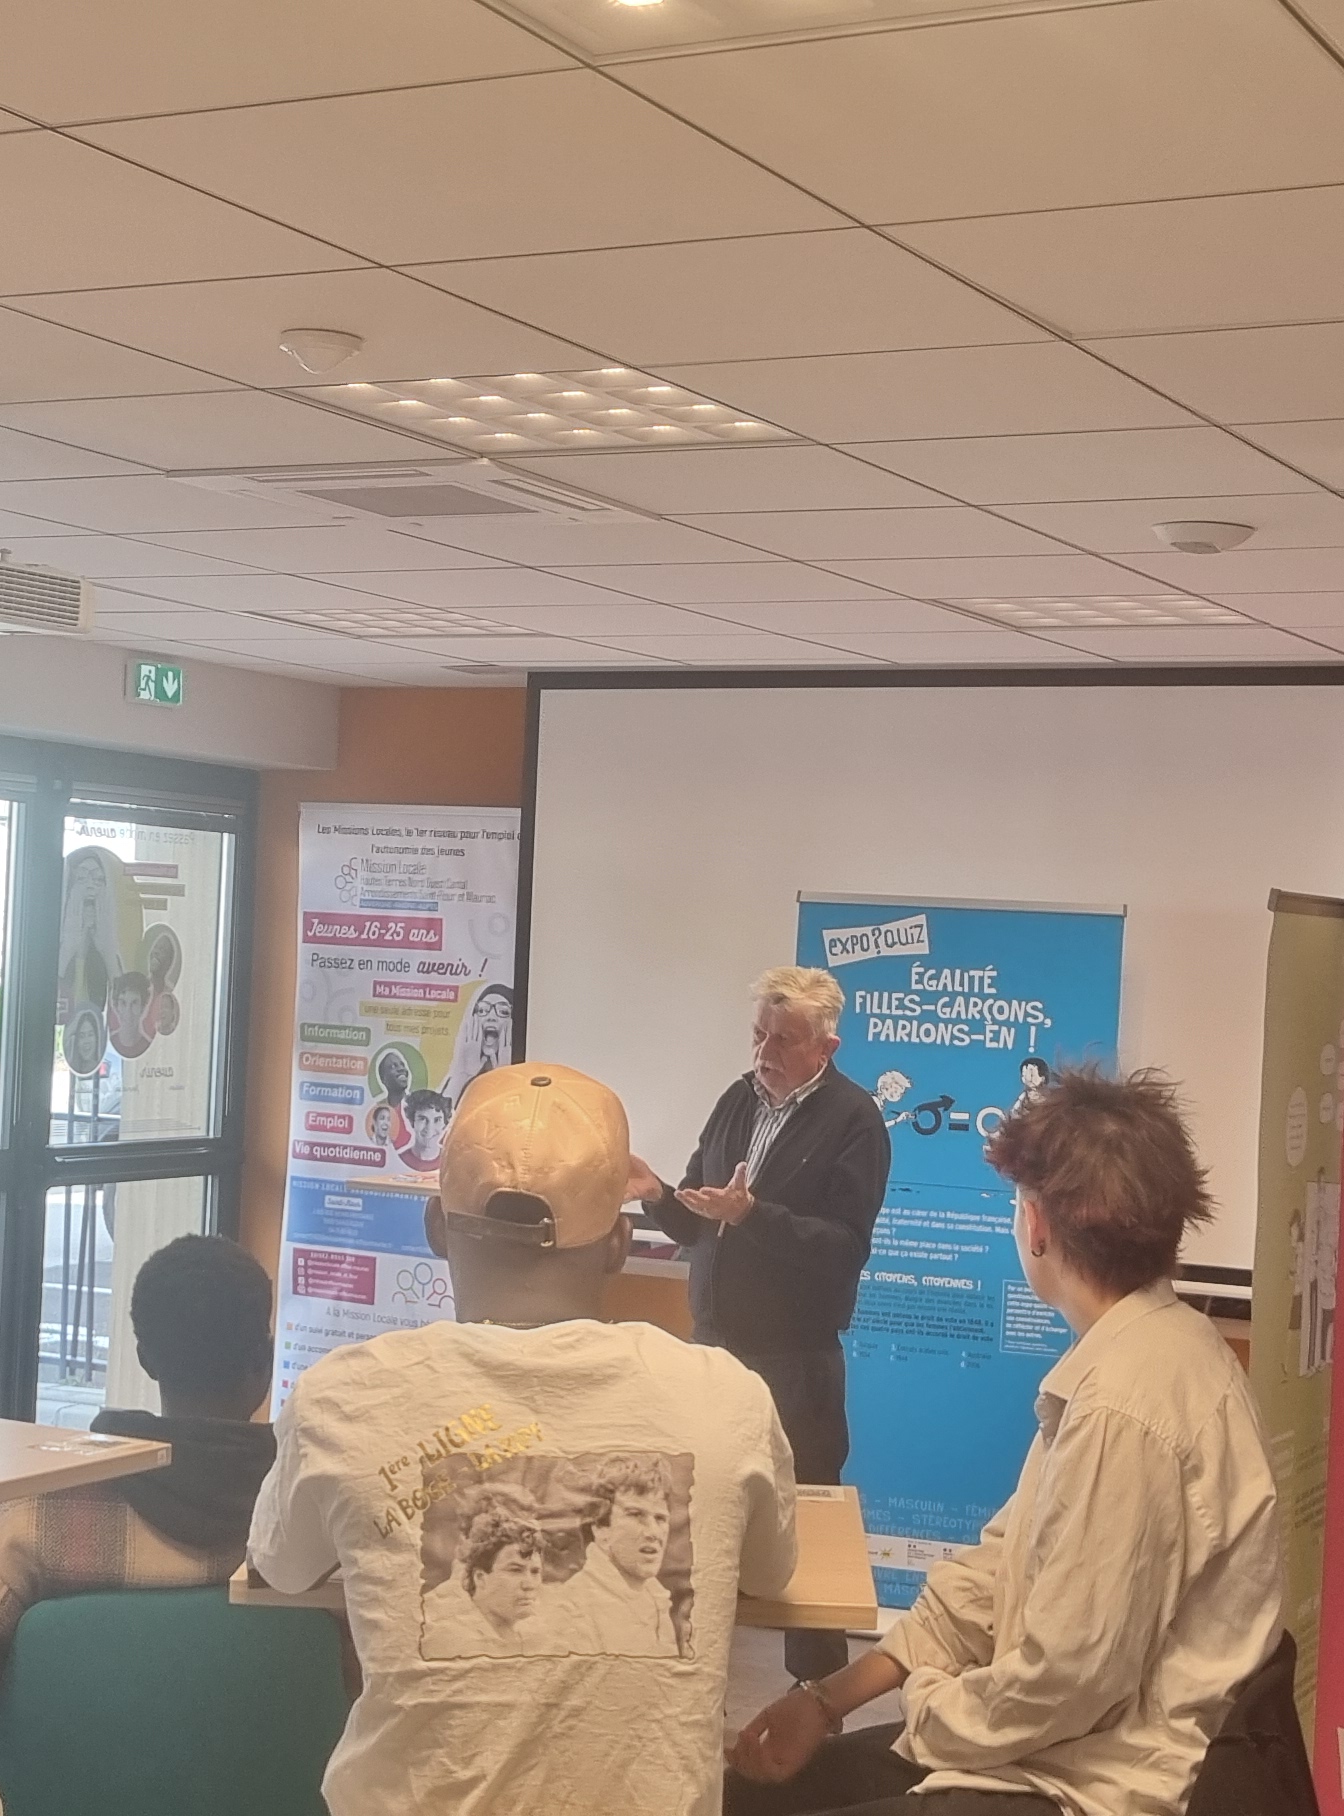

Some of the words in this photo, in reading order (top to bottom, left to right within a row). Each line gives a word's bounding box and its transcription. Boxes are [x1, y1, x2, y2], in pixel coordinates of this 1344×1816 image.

[360, 858, 396, 873] Mission
[398, 860, 426, 875] Locale
[307, 918, 358, 936] Jeunes
[361, 921, 405, 940] 16-25
[409, 928, 439, 942] ans
[311, 953, 354, 970] Passez
[358, 959, 373, 971] en
[377, 957, 411, 973] mode
[416, 958, 471, 977] avenir
[478, 958, 488, 977] !
[910, 962, 998, 993] ÉGALITÉ
[376, 984, 390, 995] Ma
[391, 985, 424, 998] Mission
[426, 987, 455, 1000] Locale
[855, 990, 1052, 1028] FILLES-GARÇONS,
[304, 1025, 366, 1040] Information
[867, 1017, 1015, 1050] PARLONS-EN
[1028, 1026, 1037, 1053] !
[303, 1054, 364, 1069] Orientation
[303, 1083, 360, 1099] Formation
[309, 1113, 348, 1129] Emploi
[295, 1141, 310, 1153] Vie
[313, 1145, 382, 1161] quotidienne
[342, 1309, 371, 1321] Mission
[888, 1497, 944, 1512] MASCULIN
